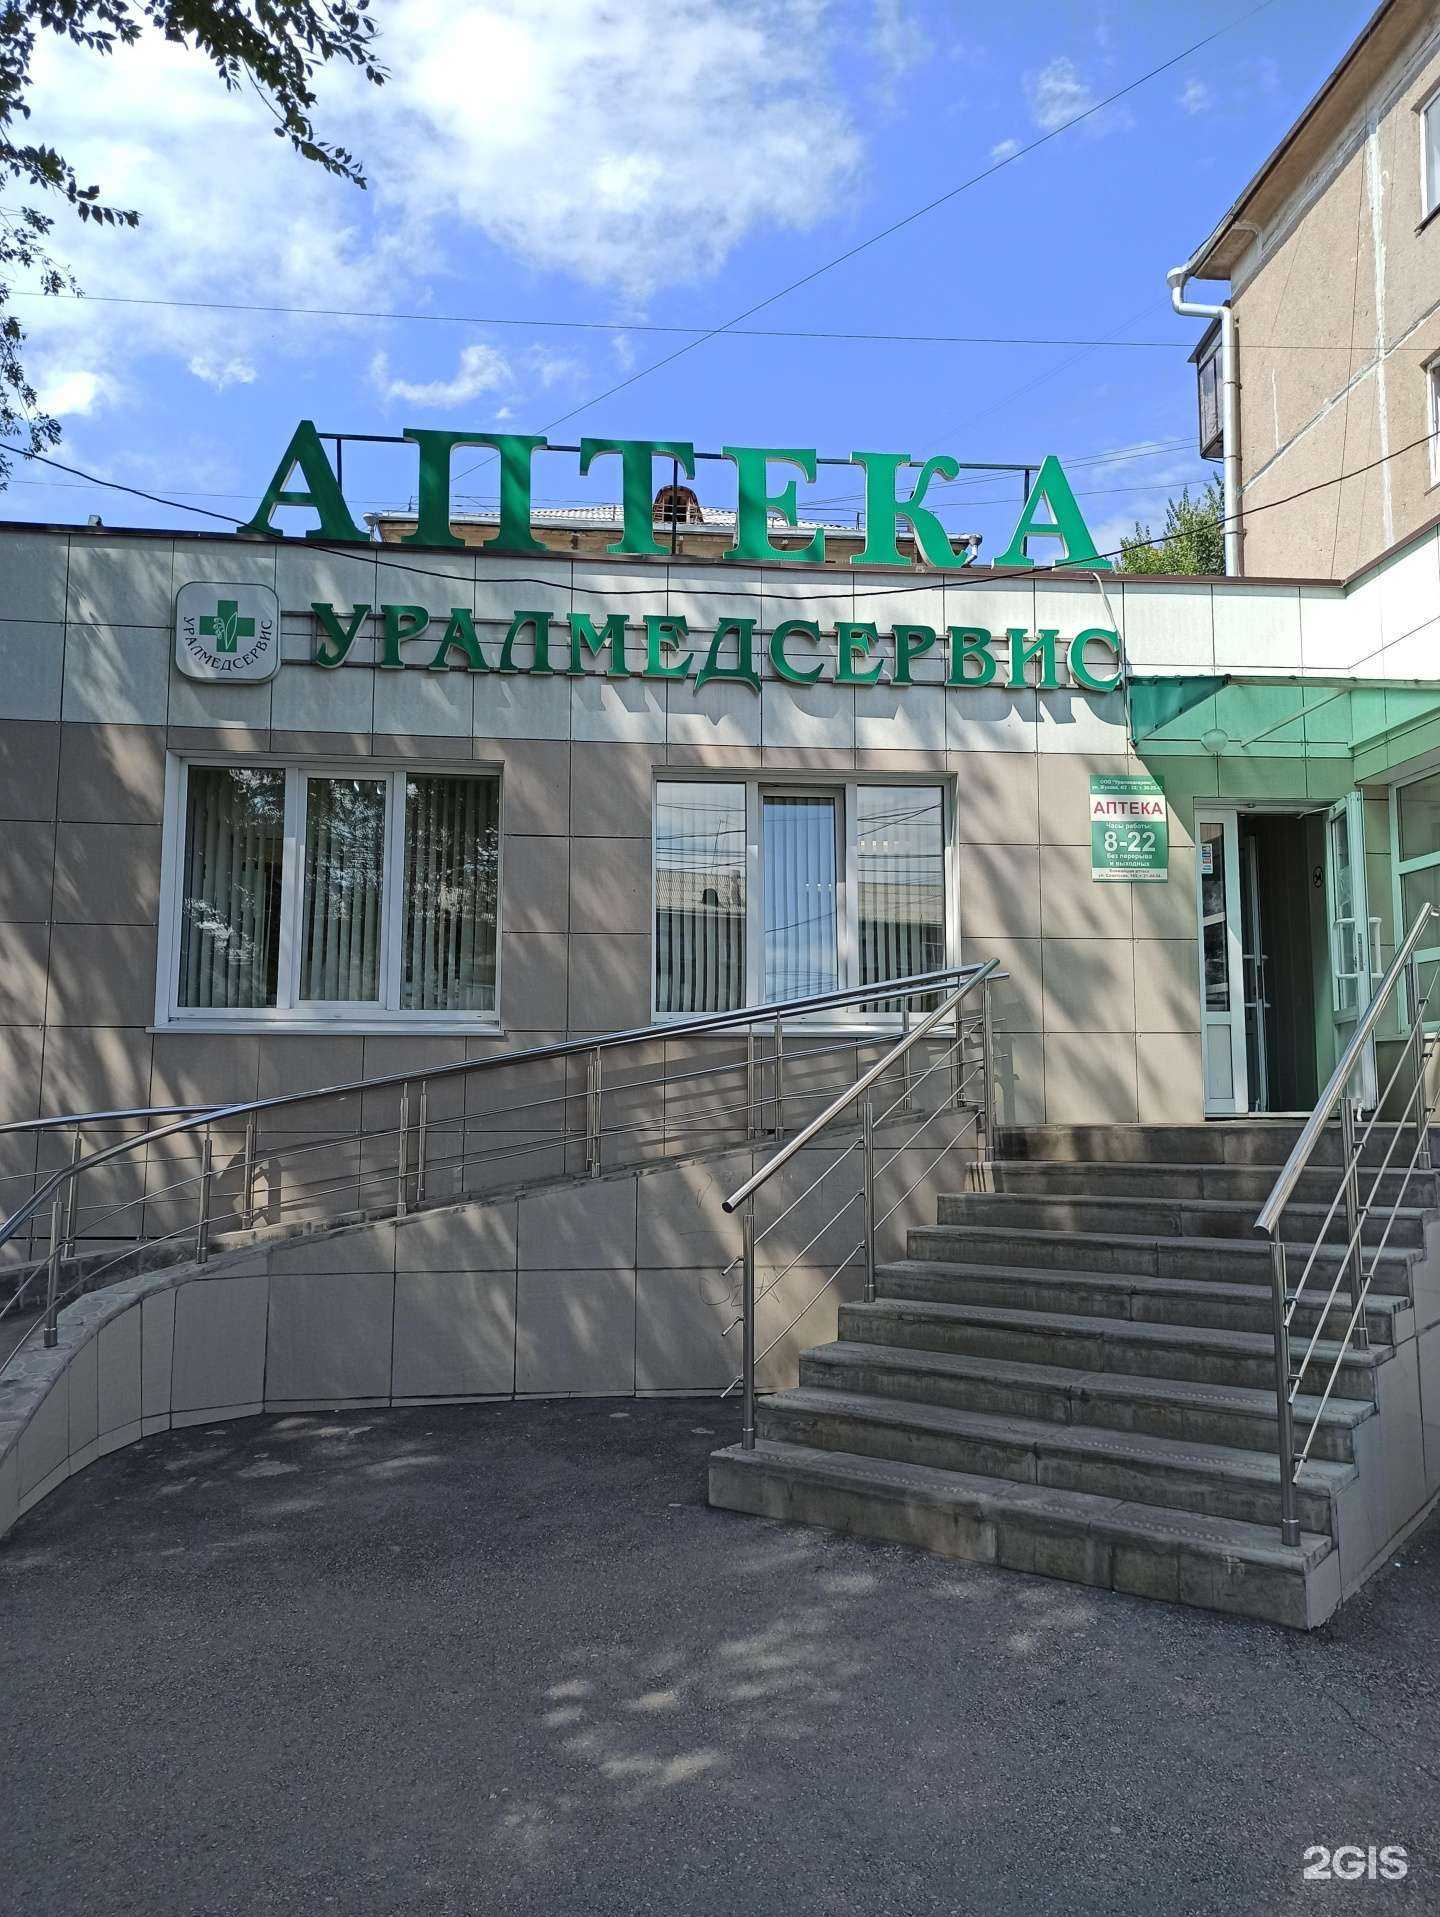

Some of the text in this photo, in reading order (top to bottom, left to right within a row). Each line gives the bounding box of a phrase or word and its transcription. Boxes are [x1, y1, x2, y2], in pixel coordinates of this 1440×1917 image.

[237, 420, 1114, 572] АПТЕКА
[183, 616, 273, 672] УРАЛМЕДСЕРВИС
[310, 602, 1121, 696] УРАЛМЕДСЕРВИС
[1094, 802, 1163, 815] АПТЕКА
[1104, 831, 1156, 852] 8-22
